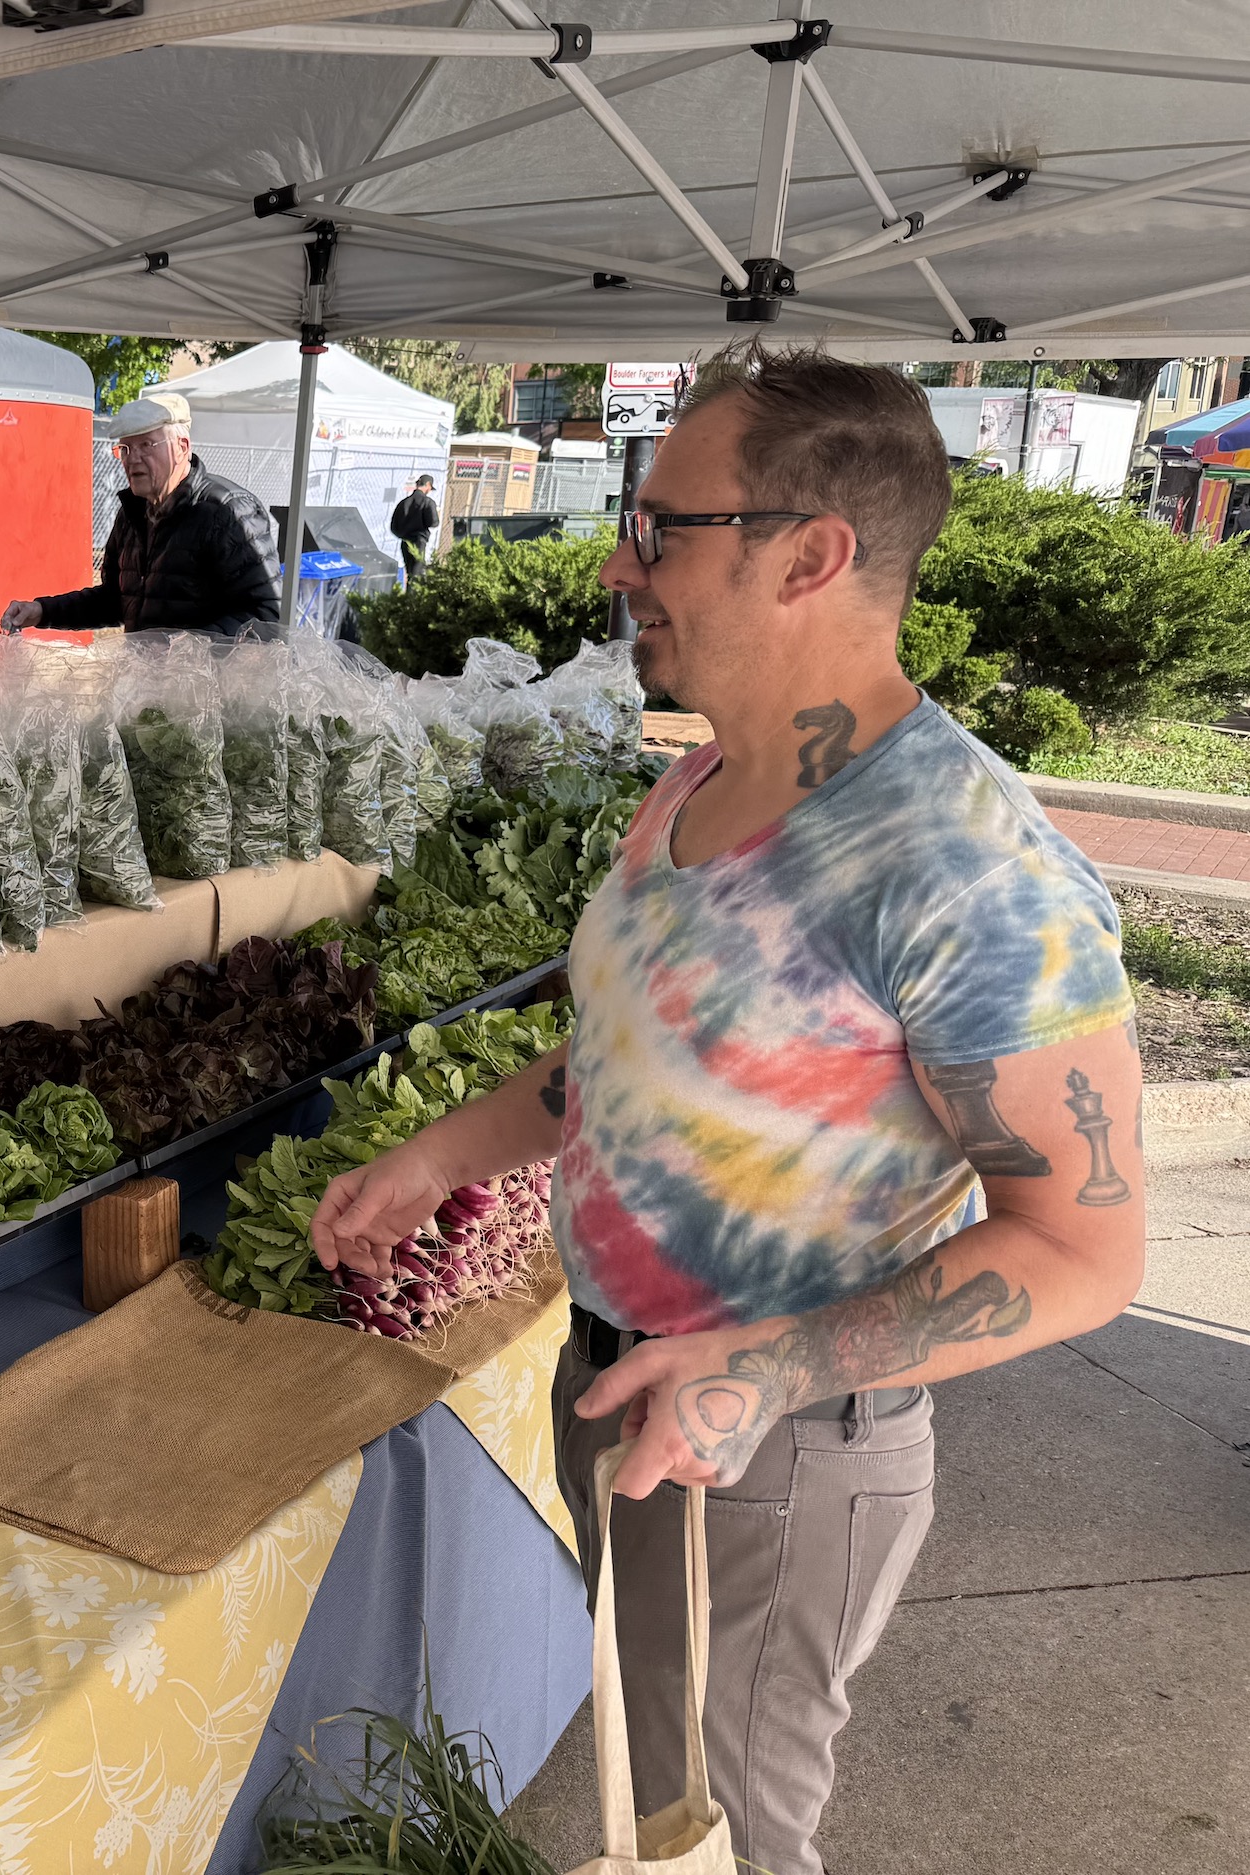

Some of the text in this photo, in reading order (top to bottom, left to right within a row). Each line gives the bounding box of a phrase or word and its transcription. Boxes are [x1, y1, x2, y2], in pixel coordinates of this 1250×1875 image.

[613, 369, 636, 378] Boulder
[639, 369, 664, 379] Farmers
[347, 423, 366, 436] Local
